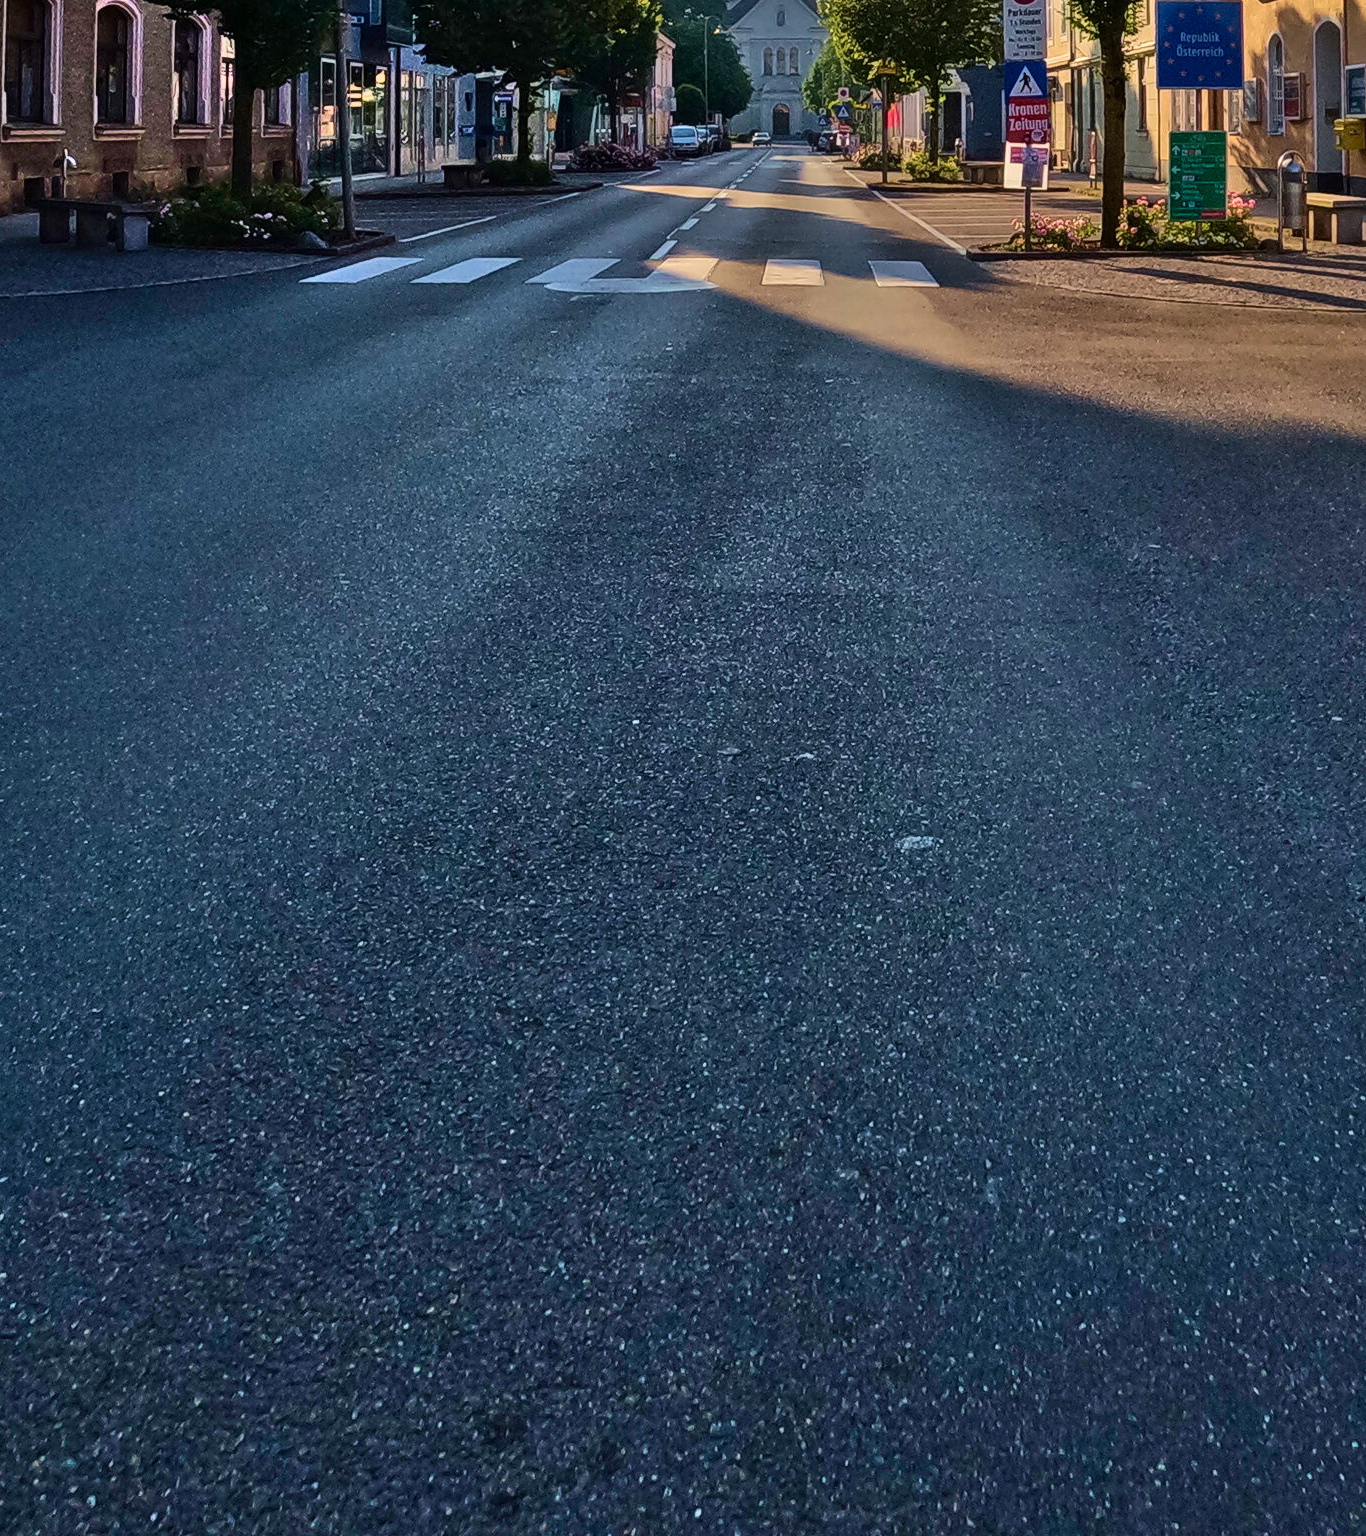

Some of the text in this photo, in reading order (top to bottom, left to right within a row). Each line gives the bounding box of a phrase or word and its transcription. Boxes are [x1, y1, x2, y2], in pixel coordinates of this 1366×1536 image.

[1007, 8, 1042, 17] Parkdauer
[1180, 31, 1220, 44] Republik
[1176, 44, 1224, 57] Österreich
[1008, 103, 1047, 117] Kronen
[1009, 117, 1049, 132] Zeitung
